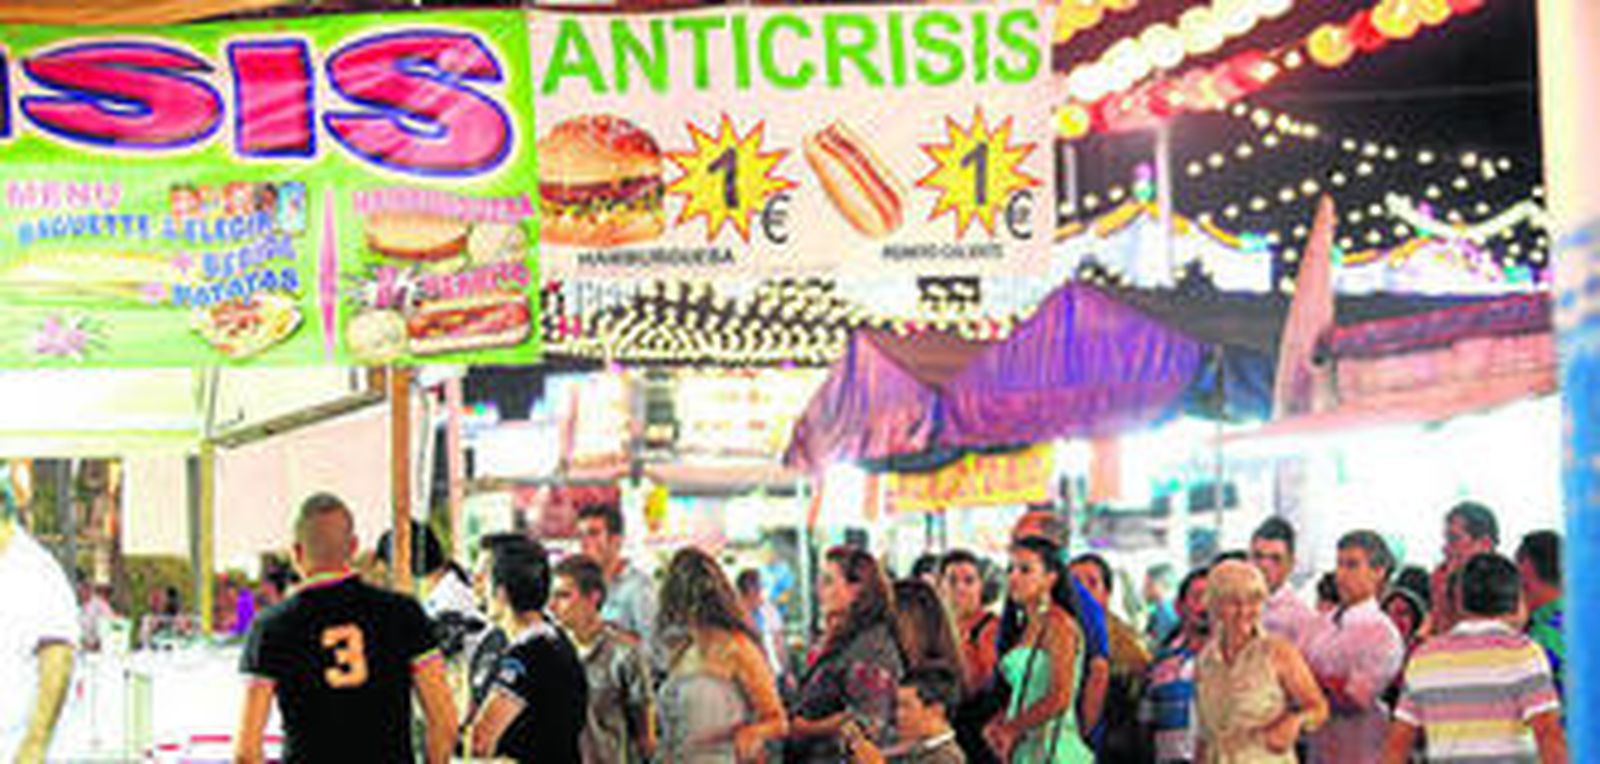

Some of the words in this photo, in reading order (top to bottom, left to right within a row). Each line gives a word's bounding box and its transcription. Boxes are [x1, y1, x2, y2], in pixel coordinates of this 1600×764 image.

[542, 11, 1044, 95] ANTICRISIS
[0, 30, 514, 177] SIS
[708, 147, 738, 209] 1
[961, 142, 989, 206] 1
[319, 623, 368, 688] 3
